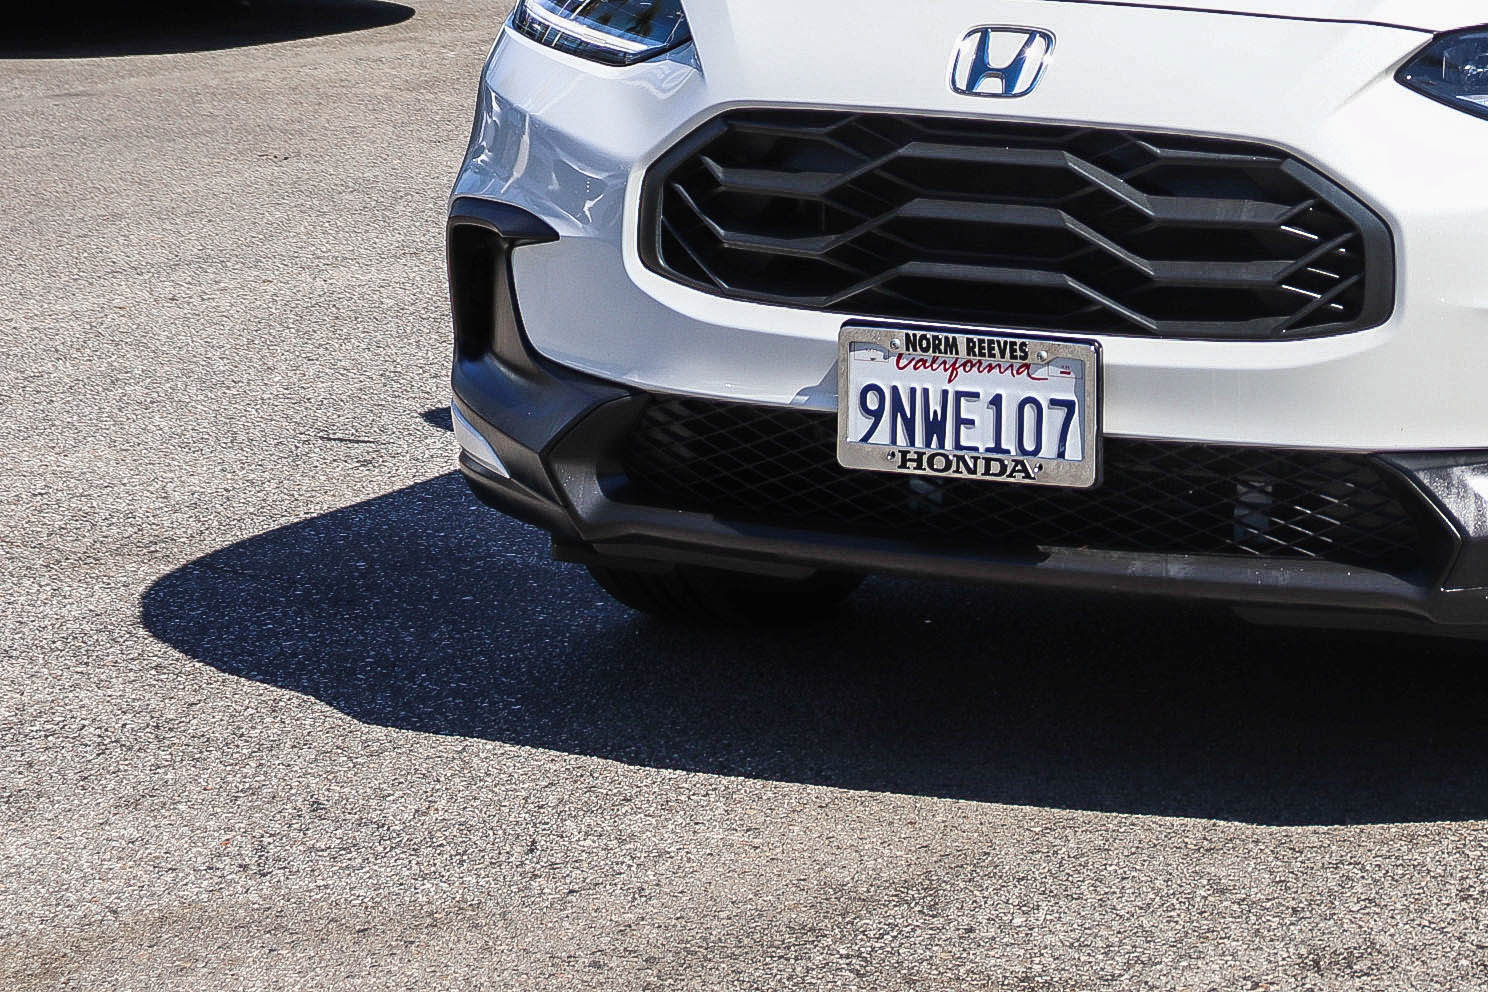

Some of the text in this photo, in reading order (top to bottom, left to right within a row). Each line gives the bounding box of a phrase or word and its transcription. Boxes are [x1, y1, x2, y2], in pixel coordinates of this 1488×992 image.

[904, 332, 1029, 361] NORM REEVES
[896, 353, 1048, 384] California
[858, 383, 1076, 458] 9NWE107
[897, 449, 1036, 480] HONDA
